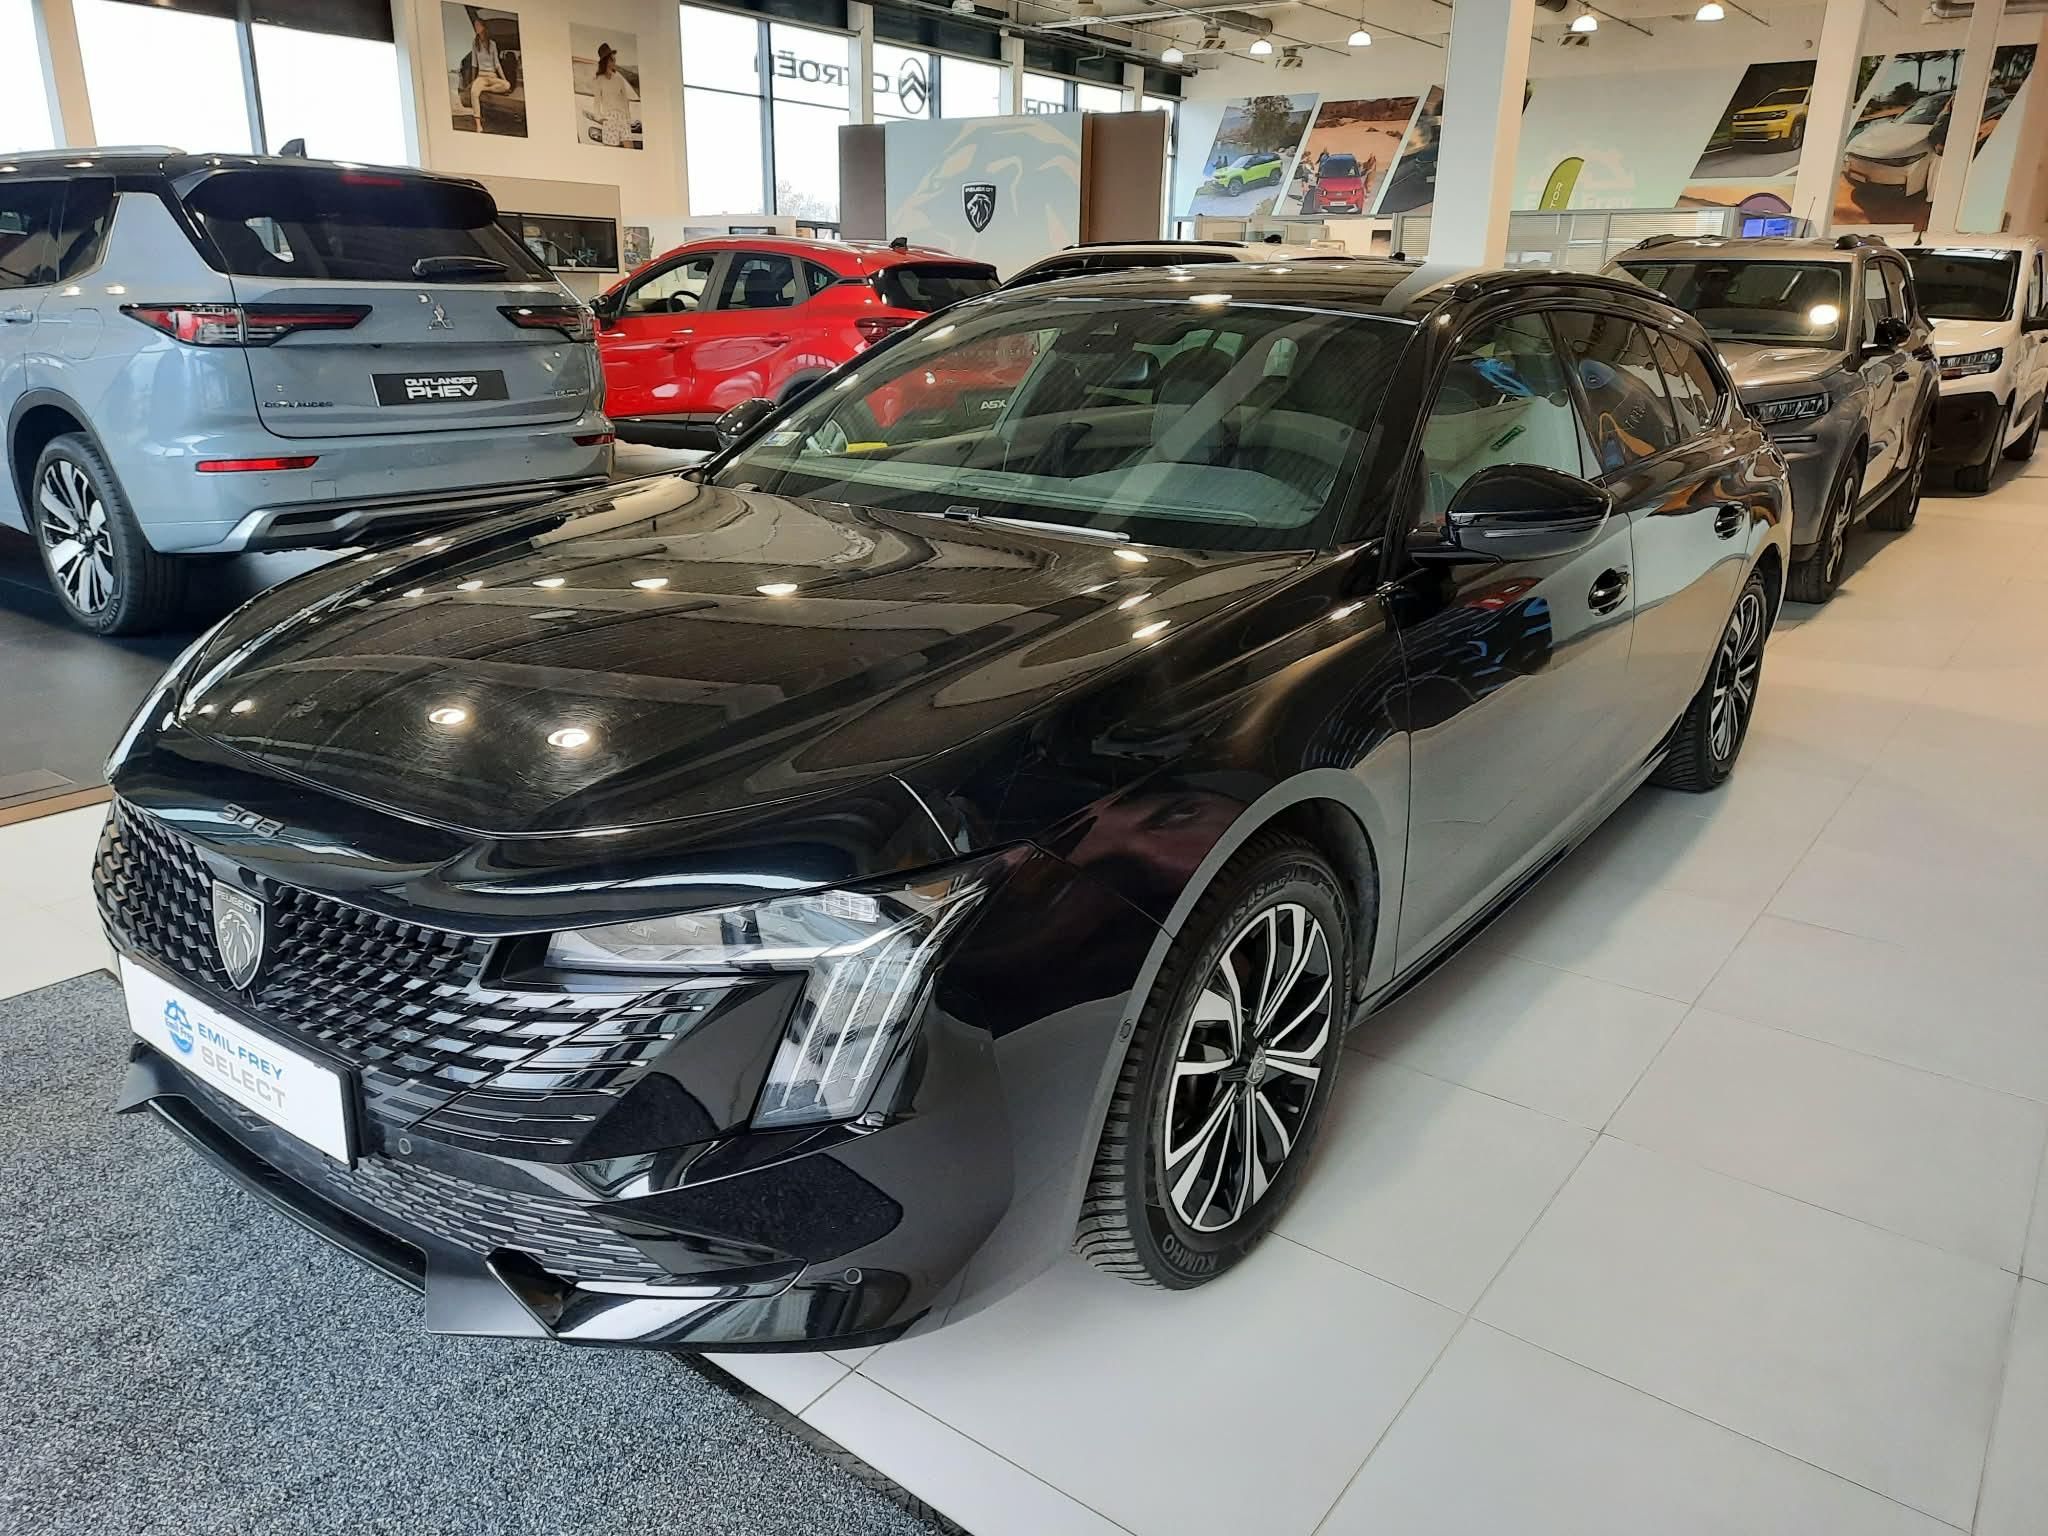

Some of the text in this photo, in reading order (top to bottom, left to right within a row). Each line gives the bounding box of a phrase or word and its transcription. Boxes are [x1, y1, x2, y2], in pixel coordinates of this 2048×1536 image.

[405, 376, 478, 386] OUTLANDER
[406, 384, 479, 400] PHEV
[980, 400, 1007, 410] ASX
[223, 803, 285, 839] 508
[214, 889, 259, 915] PEUGEOT
[198, 1023, 282, 1080] EMIL FREY
[202, 1046, 286, 1108] SELECT
[1162, 1233, 1218, 1272] KUMHO
